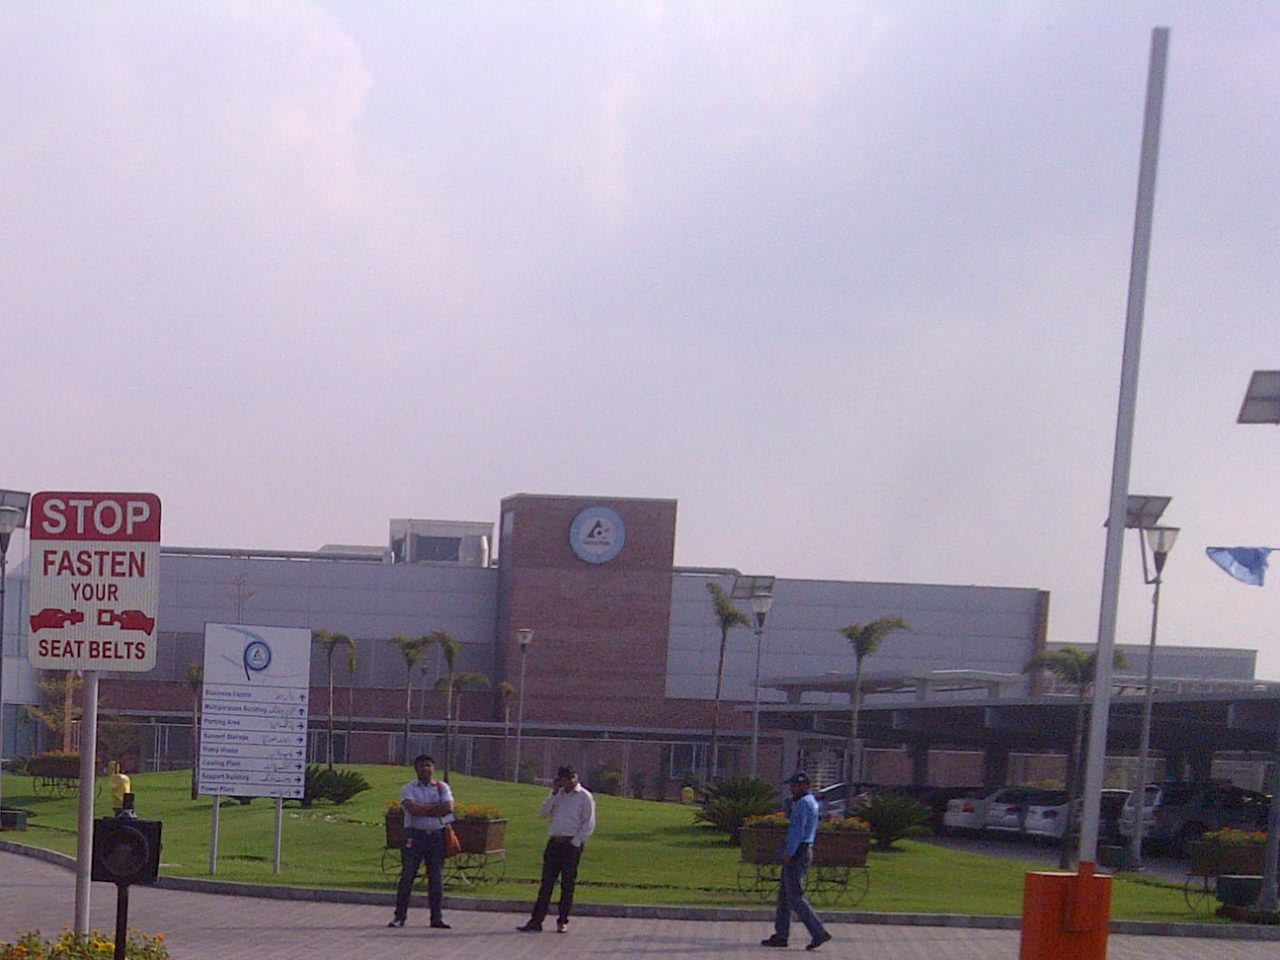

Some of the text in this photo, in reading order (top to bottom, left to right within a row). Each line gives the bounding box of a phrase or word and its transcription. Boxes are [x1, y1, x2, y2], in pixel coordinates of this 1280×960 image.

[41, 499, 150, 535] STOP
[43, 550, 146, 577] FASTEN
[70, 583, 119, 601] YOUR
[38, 639, 146, 660] SEAT BELTS
